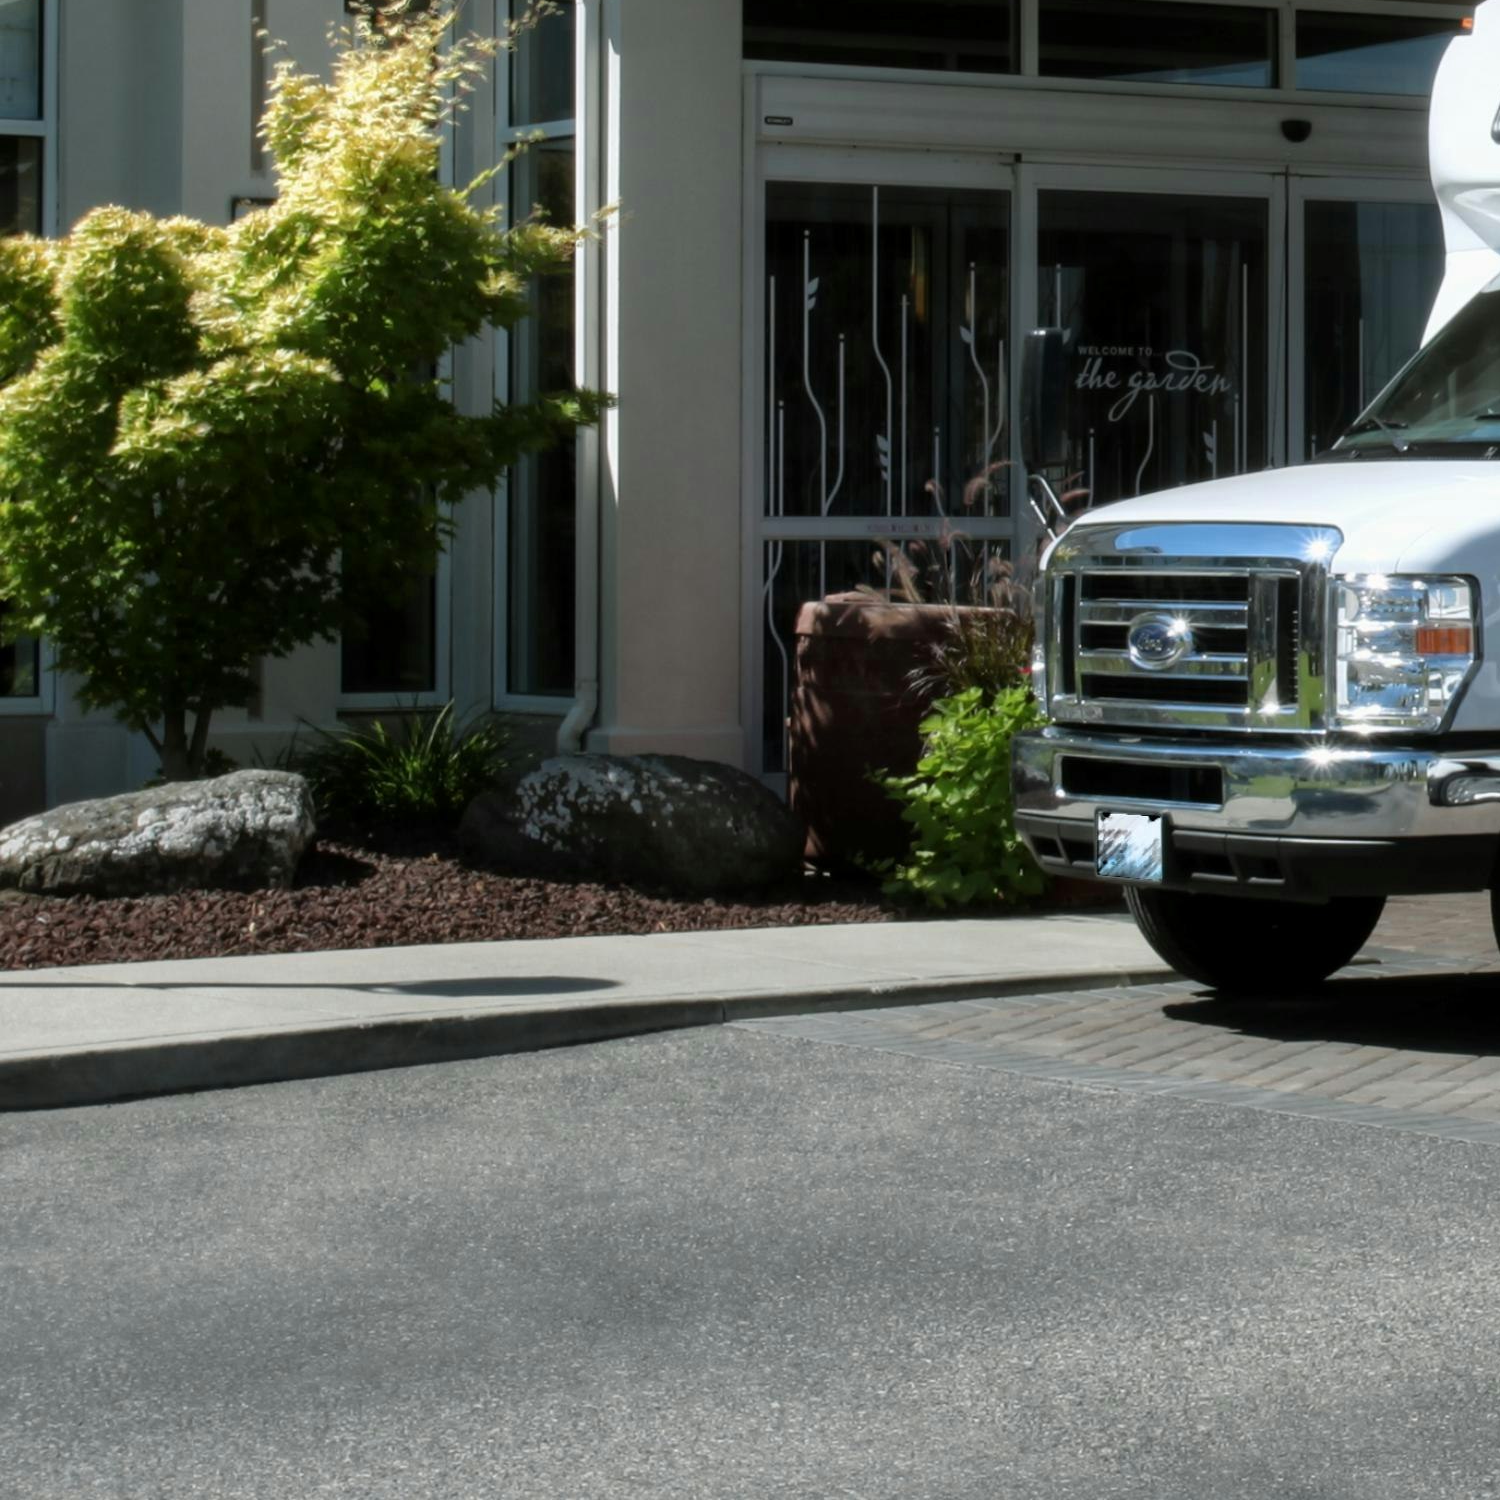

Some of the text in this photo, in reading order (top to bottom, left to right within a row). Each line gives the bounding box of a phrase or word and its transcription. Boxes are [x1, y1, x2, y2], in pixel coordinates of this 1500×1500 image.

[1077, 346, 1134, 356] WELCOME
[1075, 350, 1231, 422] the garden
